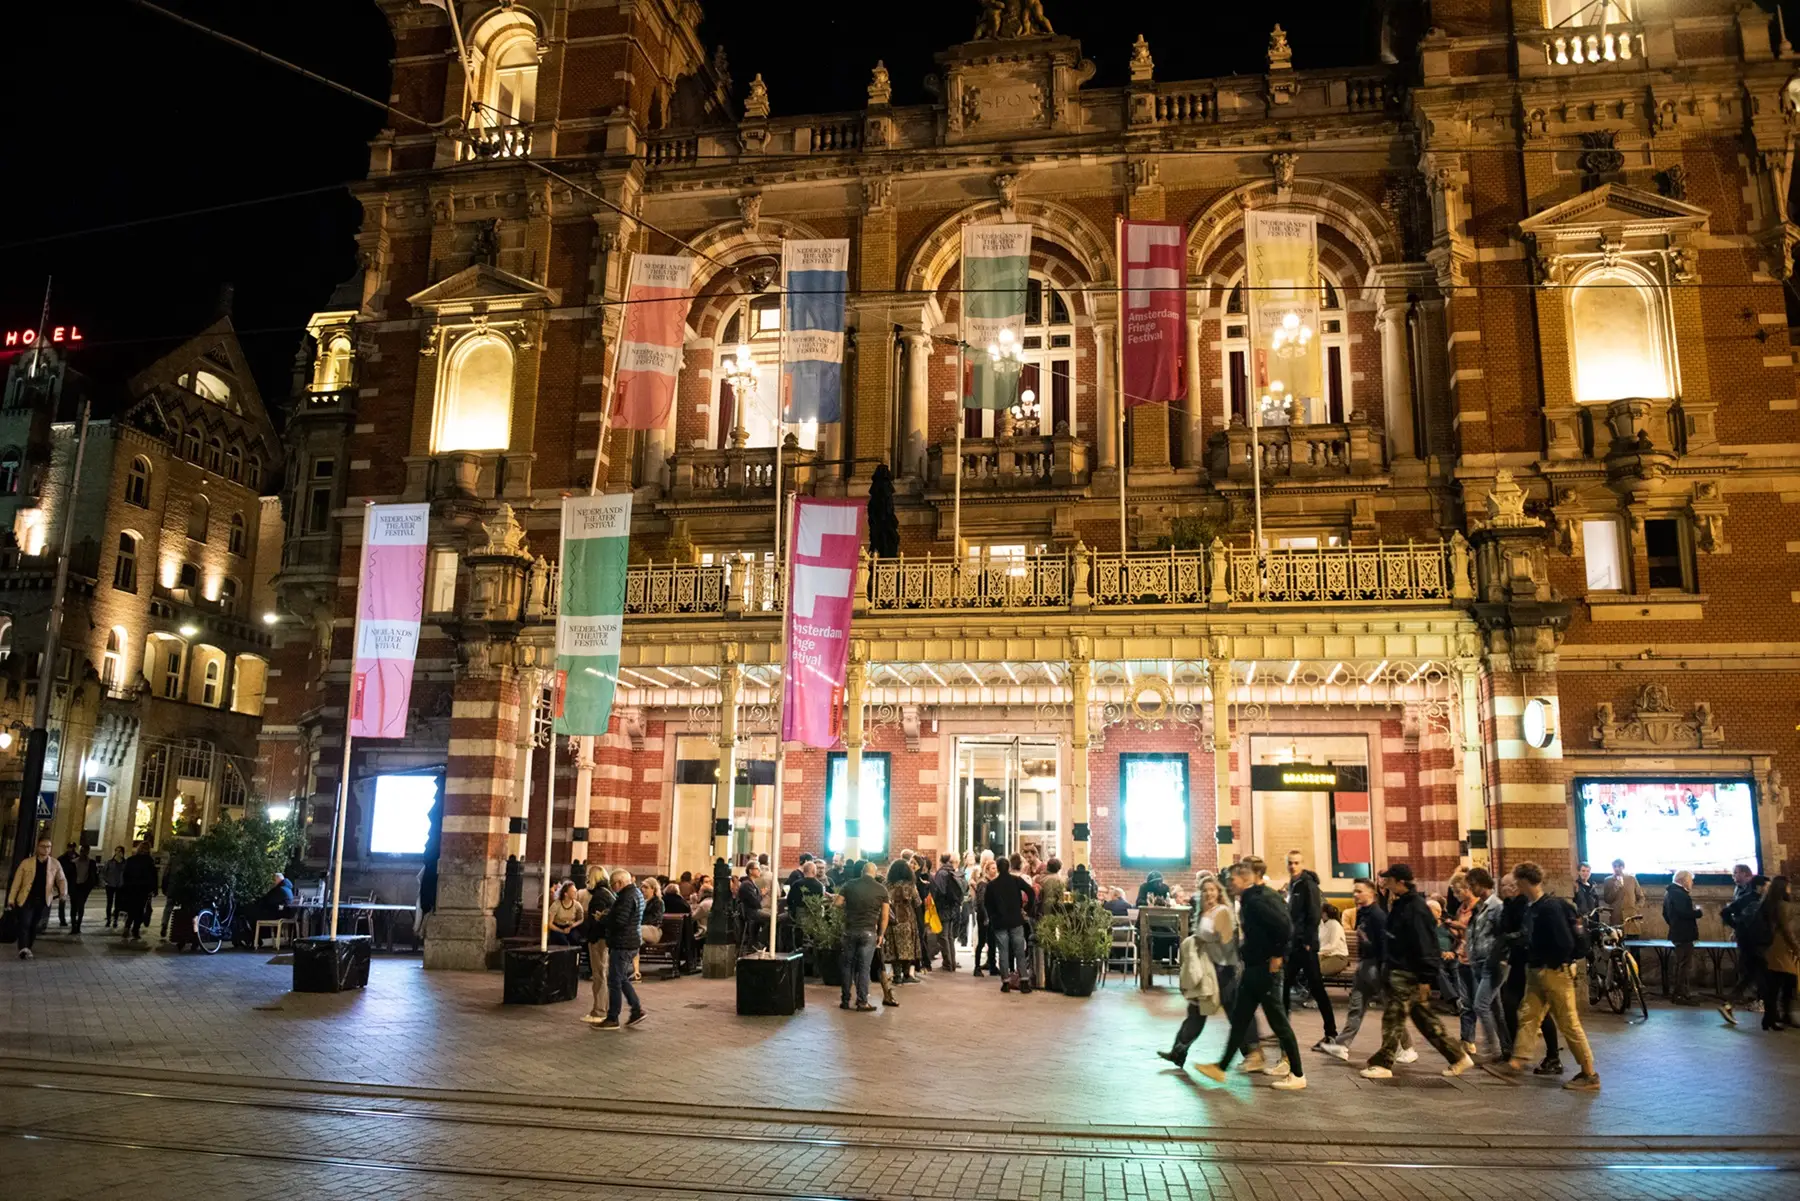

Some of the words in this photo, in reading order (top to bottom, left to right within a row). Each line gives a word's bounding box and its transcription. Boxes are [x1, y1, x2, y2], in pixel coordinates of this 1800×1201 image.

[976, 232, 1023, 240] NEDERLANDS
[644, 262, 686, 272] NEDERLANDS
[648, 274, 678, 282] FESTIVAL
[1128, 308, 1180, 322] Amsterdam
[1128, 321, 1156, 333] Fringe
[5, 326, 83, 347] HOEL
[1128, 330, 1163, 344] Festival
[576, 506, 624, 516] NEDERLANDS
[380, 515, 422, 523] NEDERLANDS
[584, 515, 616, 523] THEATER
[386, 522, 416, 530] THEATER
[584, 522, 616, 530] FESTIVAL
[568, 624, 617, 632] NEDERLANDS
[371, 628, 413, 637] NERLANDS
[576, 632, 608, 640] THEATER
[375, 642, 402, 650] STIVAL
[574, 638, 608, 647] FESTIVAL
[792, 650, 822, 668] etival
